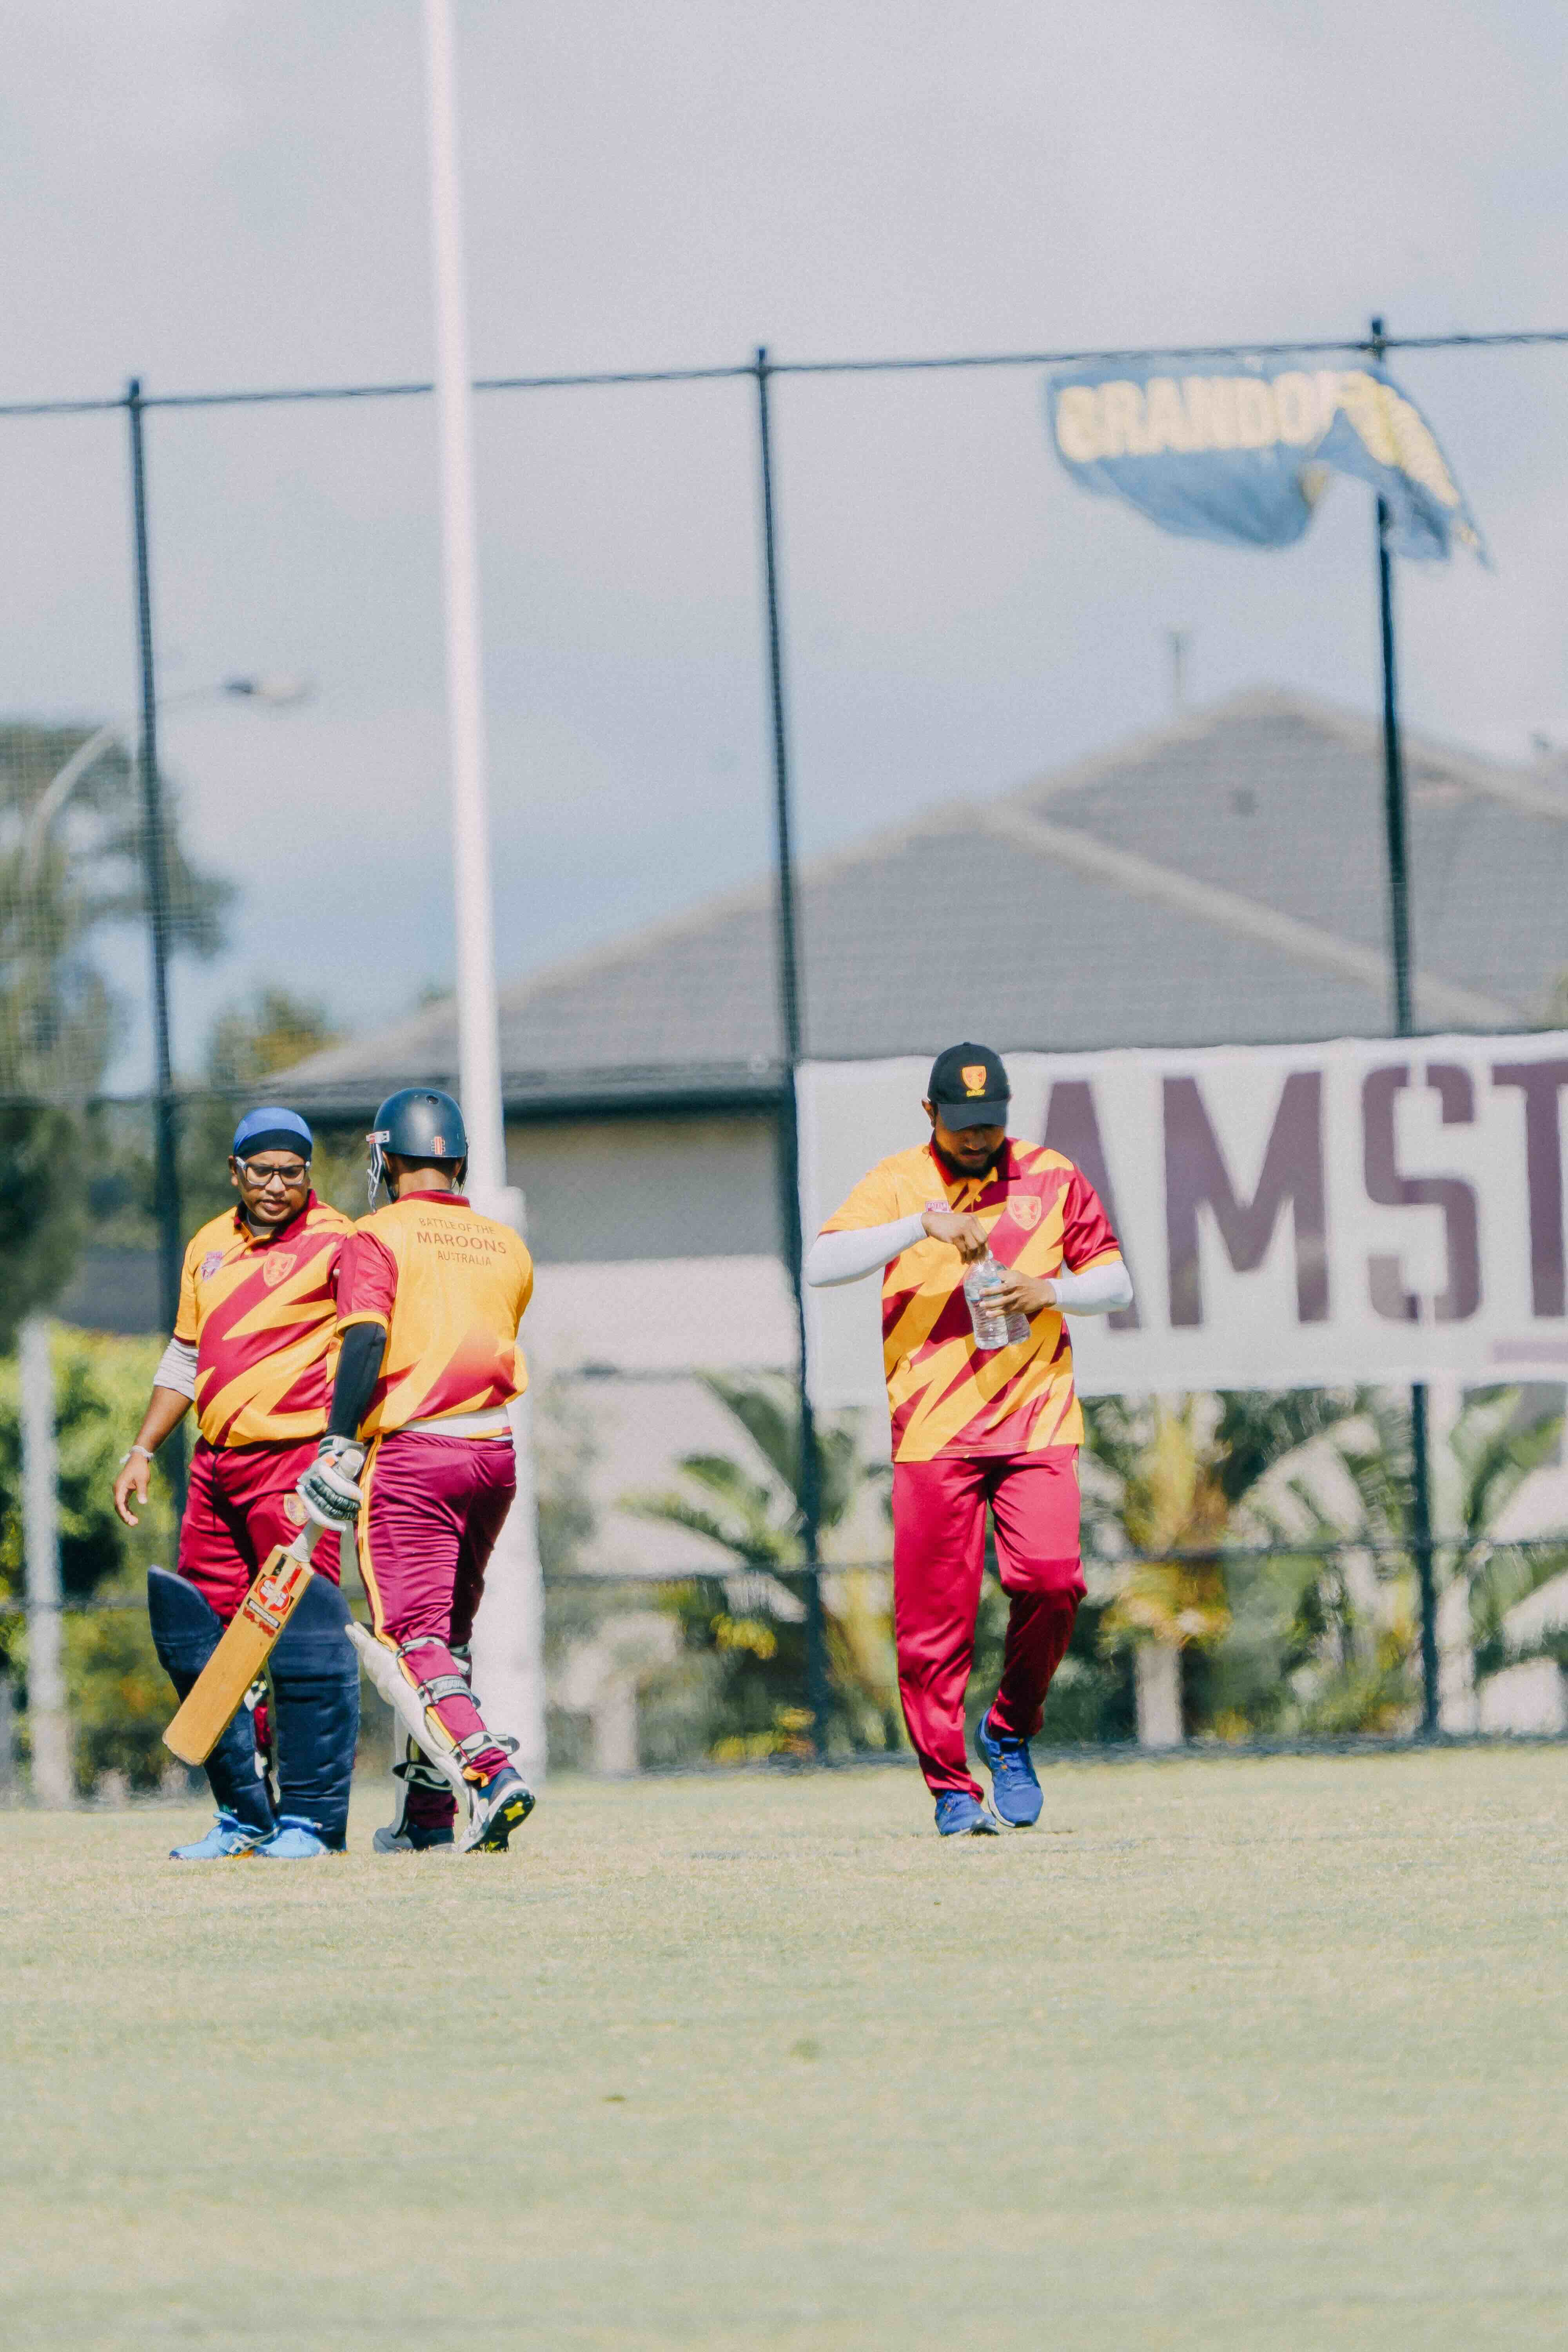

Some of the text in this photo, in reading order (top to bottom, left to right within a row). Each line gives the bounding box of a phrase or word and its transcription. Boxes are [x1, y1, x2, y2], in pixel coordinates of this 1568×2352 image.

[419, 1217, 496, 1234] BATTLE OF THE
[417, 1232, 506, 1254] MAROONS
